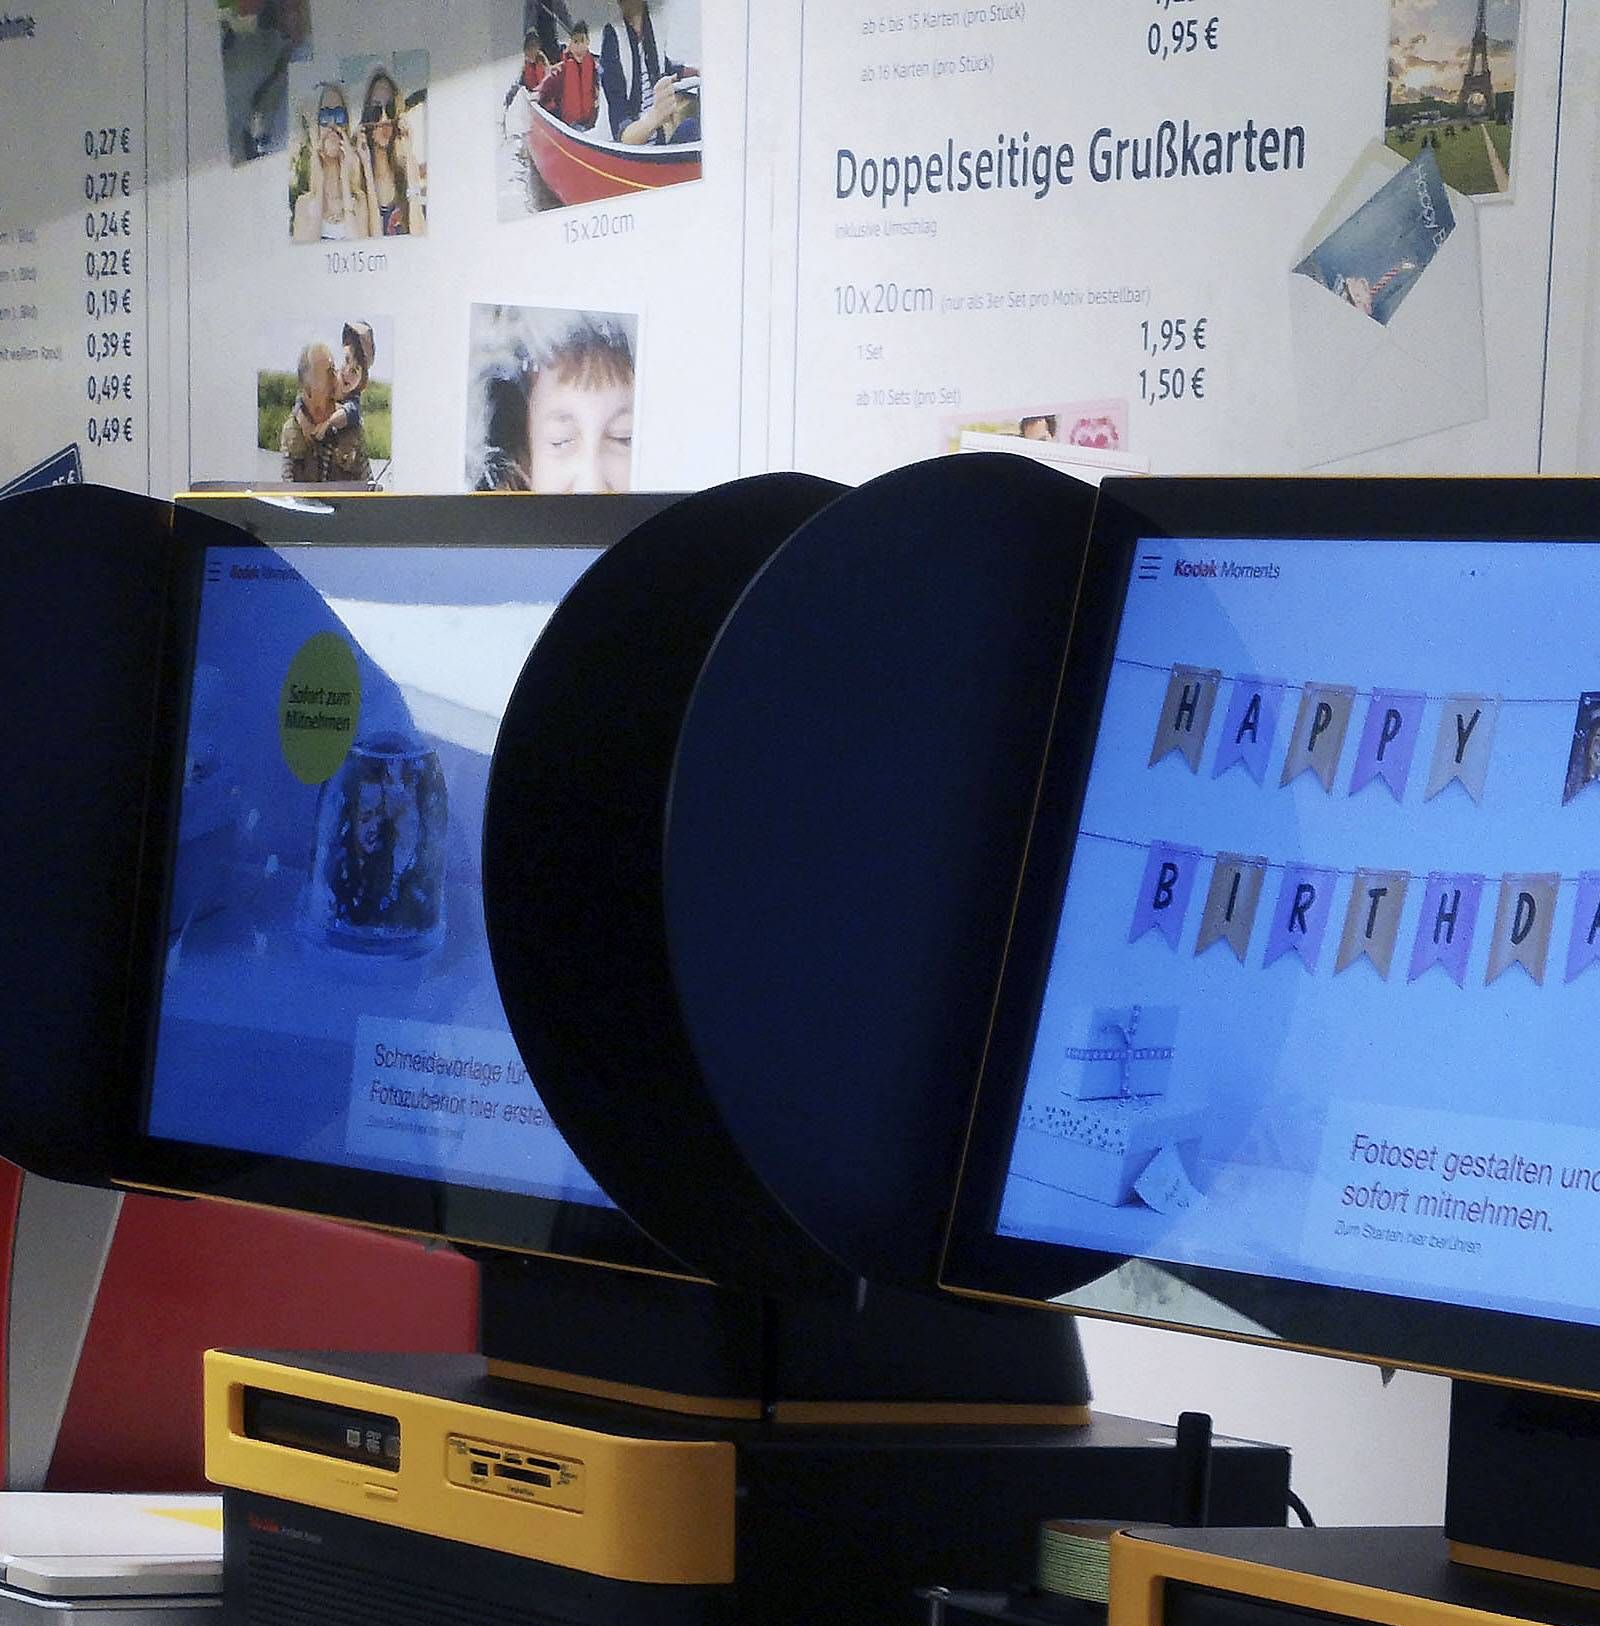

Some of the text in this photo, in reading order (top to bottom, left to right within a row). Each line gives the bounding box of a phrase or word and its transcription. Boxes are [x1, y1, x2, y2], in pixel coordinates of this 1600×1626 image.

[835, 119, 1305, 206] Doppelseitige Grußkarten
[1173, 559, 1280, 580] Kodak Moments
[1351, 1135, 1438, 1172] Fotoset
[1443, 1148, 1553, 1185] gestalten
[1341, 1182, 1554, 1233] sofort mitnehmen.
